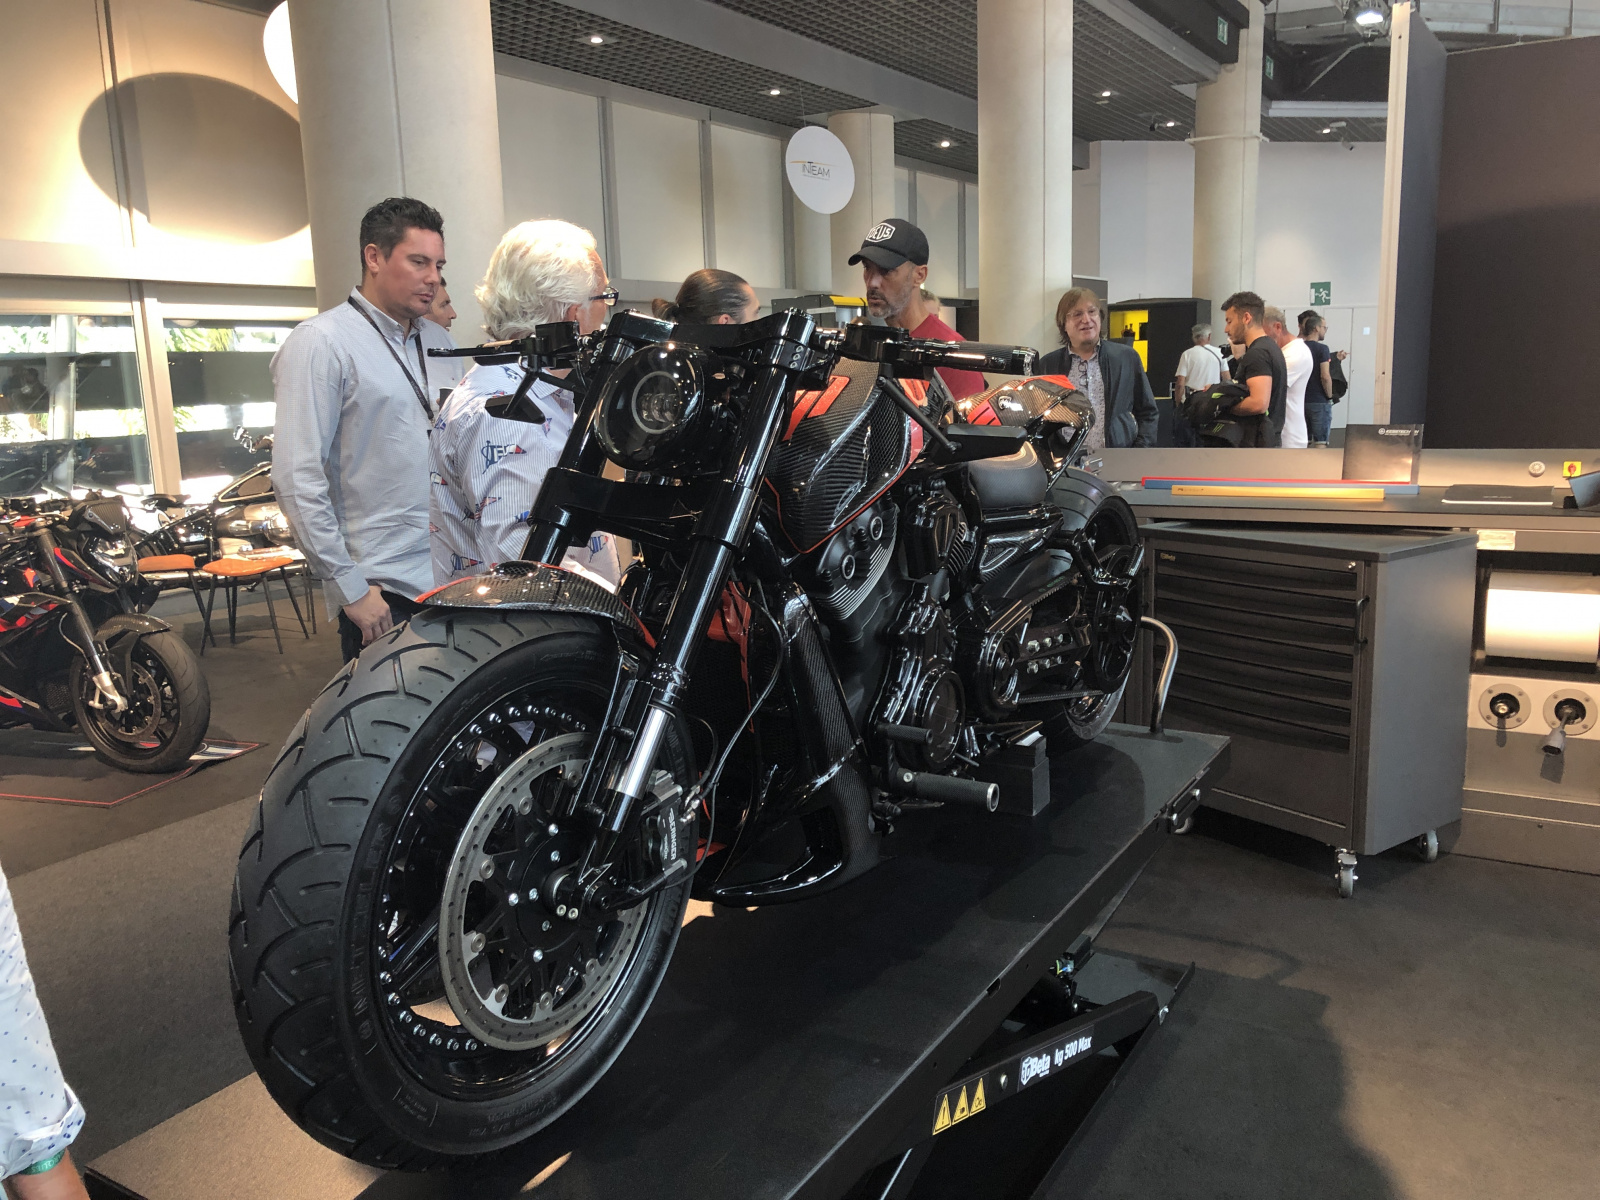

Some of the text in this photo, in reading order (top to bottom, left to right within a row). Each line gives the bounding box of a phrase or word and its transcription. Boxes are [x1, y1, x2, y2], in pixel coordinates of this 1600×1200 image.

[1054, 1048, 1064, 1066] kg
[1064, 1040, 1078, 1060] 500
[1077, 1036, 1092, 1053] Max
